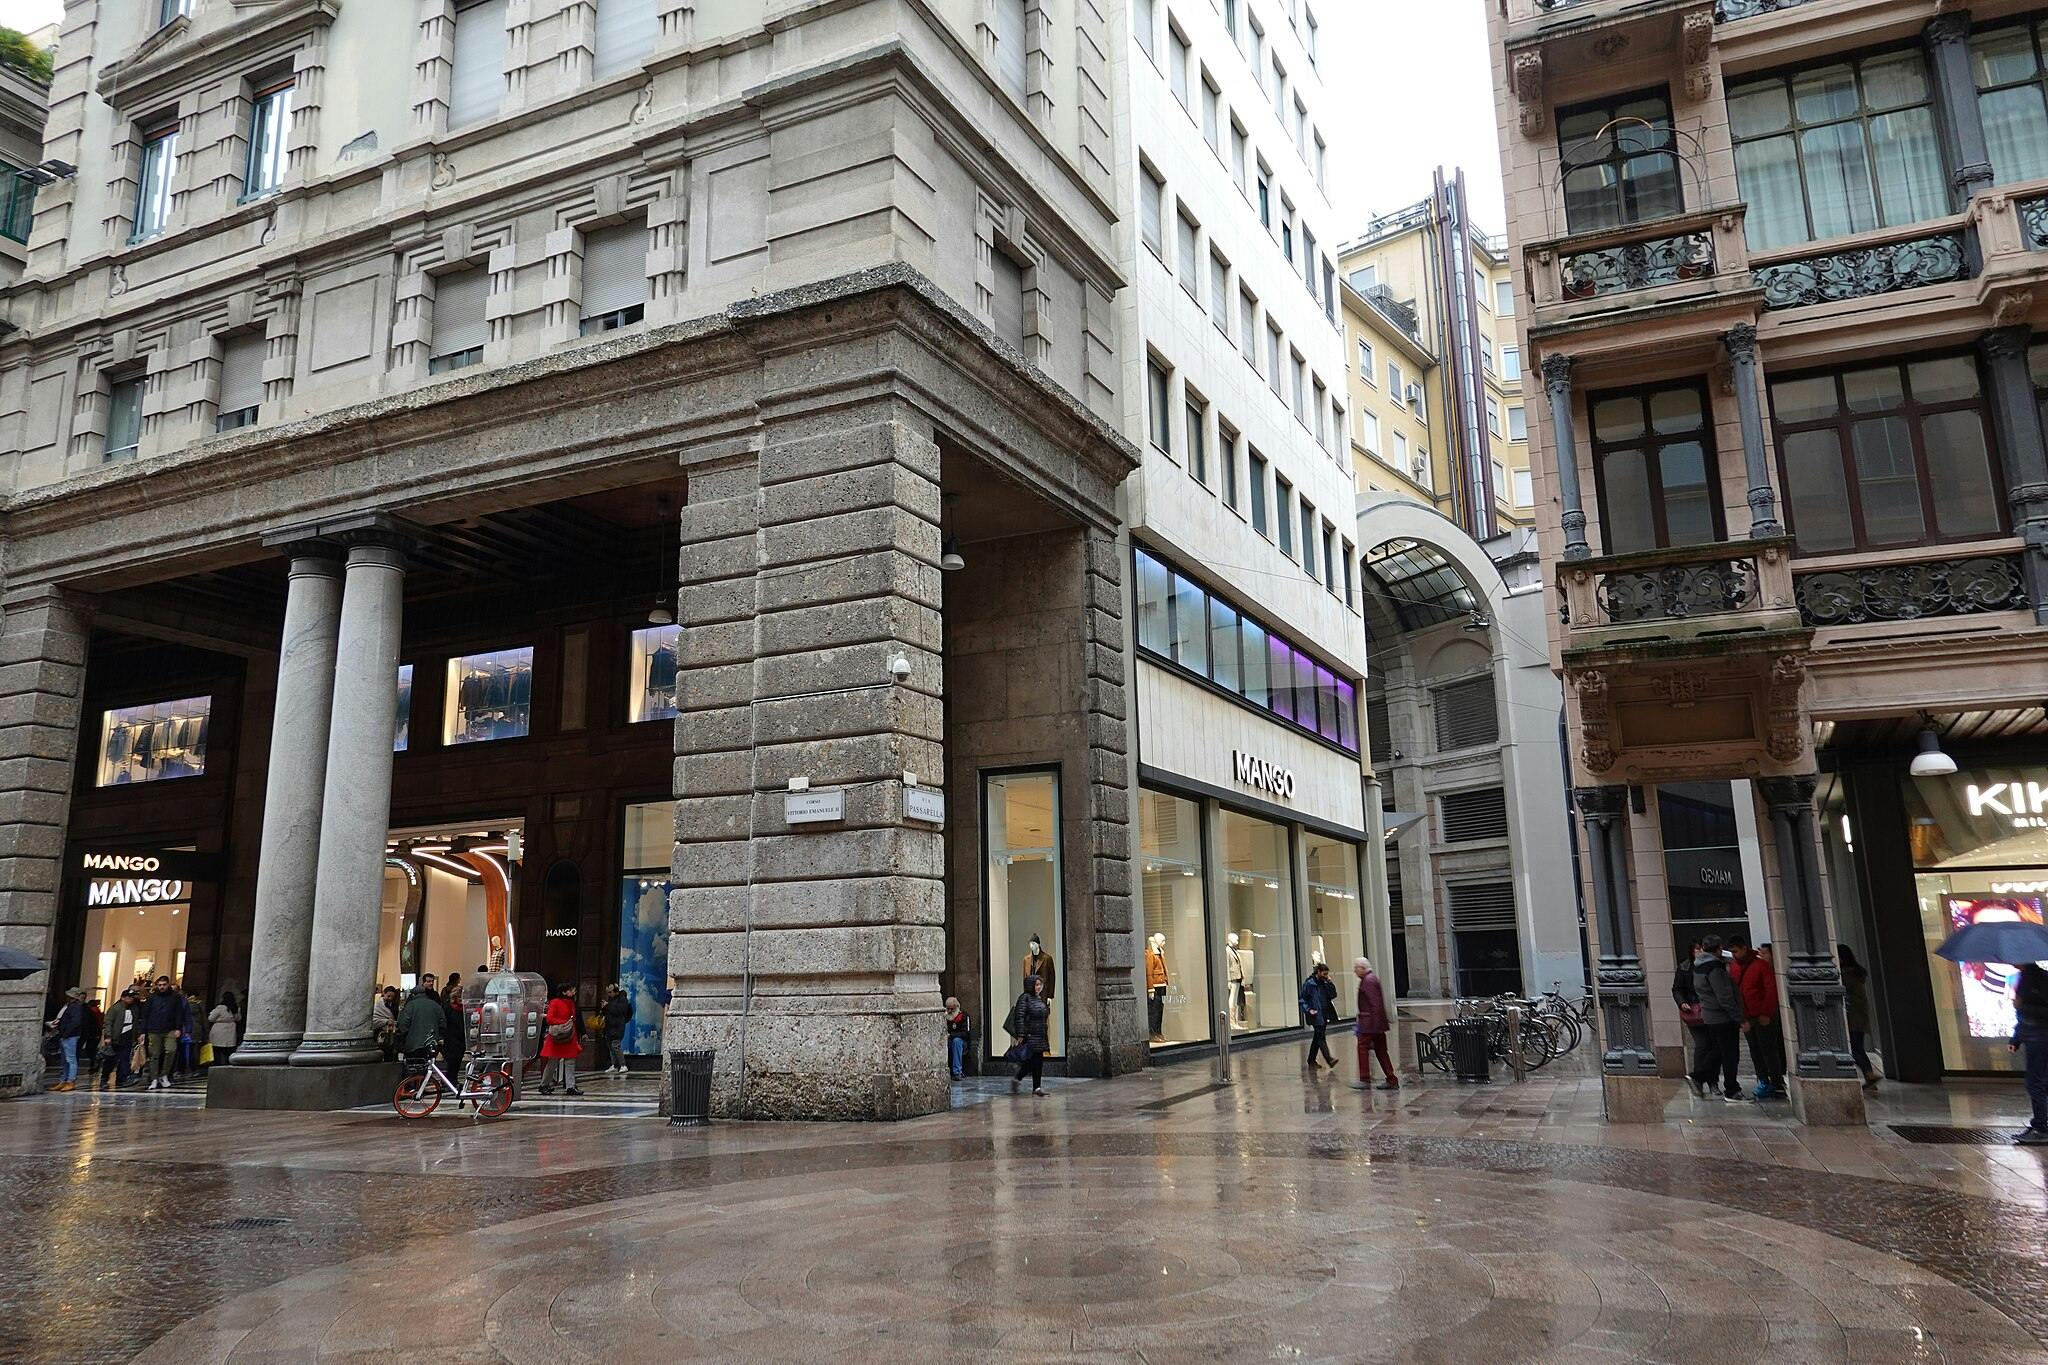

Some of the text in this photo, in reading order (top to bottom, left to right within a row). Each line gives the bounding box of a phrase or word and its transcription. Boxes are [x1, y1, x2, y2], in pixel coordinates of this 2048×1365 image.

[1233, 749, 1295, 799] MANGO
[909, 804, 944, 818] PASSARELLA
[83, 853, 160, 872] MANGO
[88, 879, 182, 906] MANGO
[545, 928, 577, 937] MANGO
